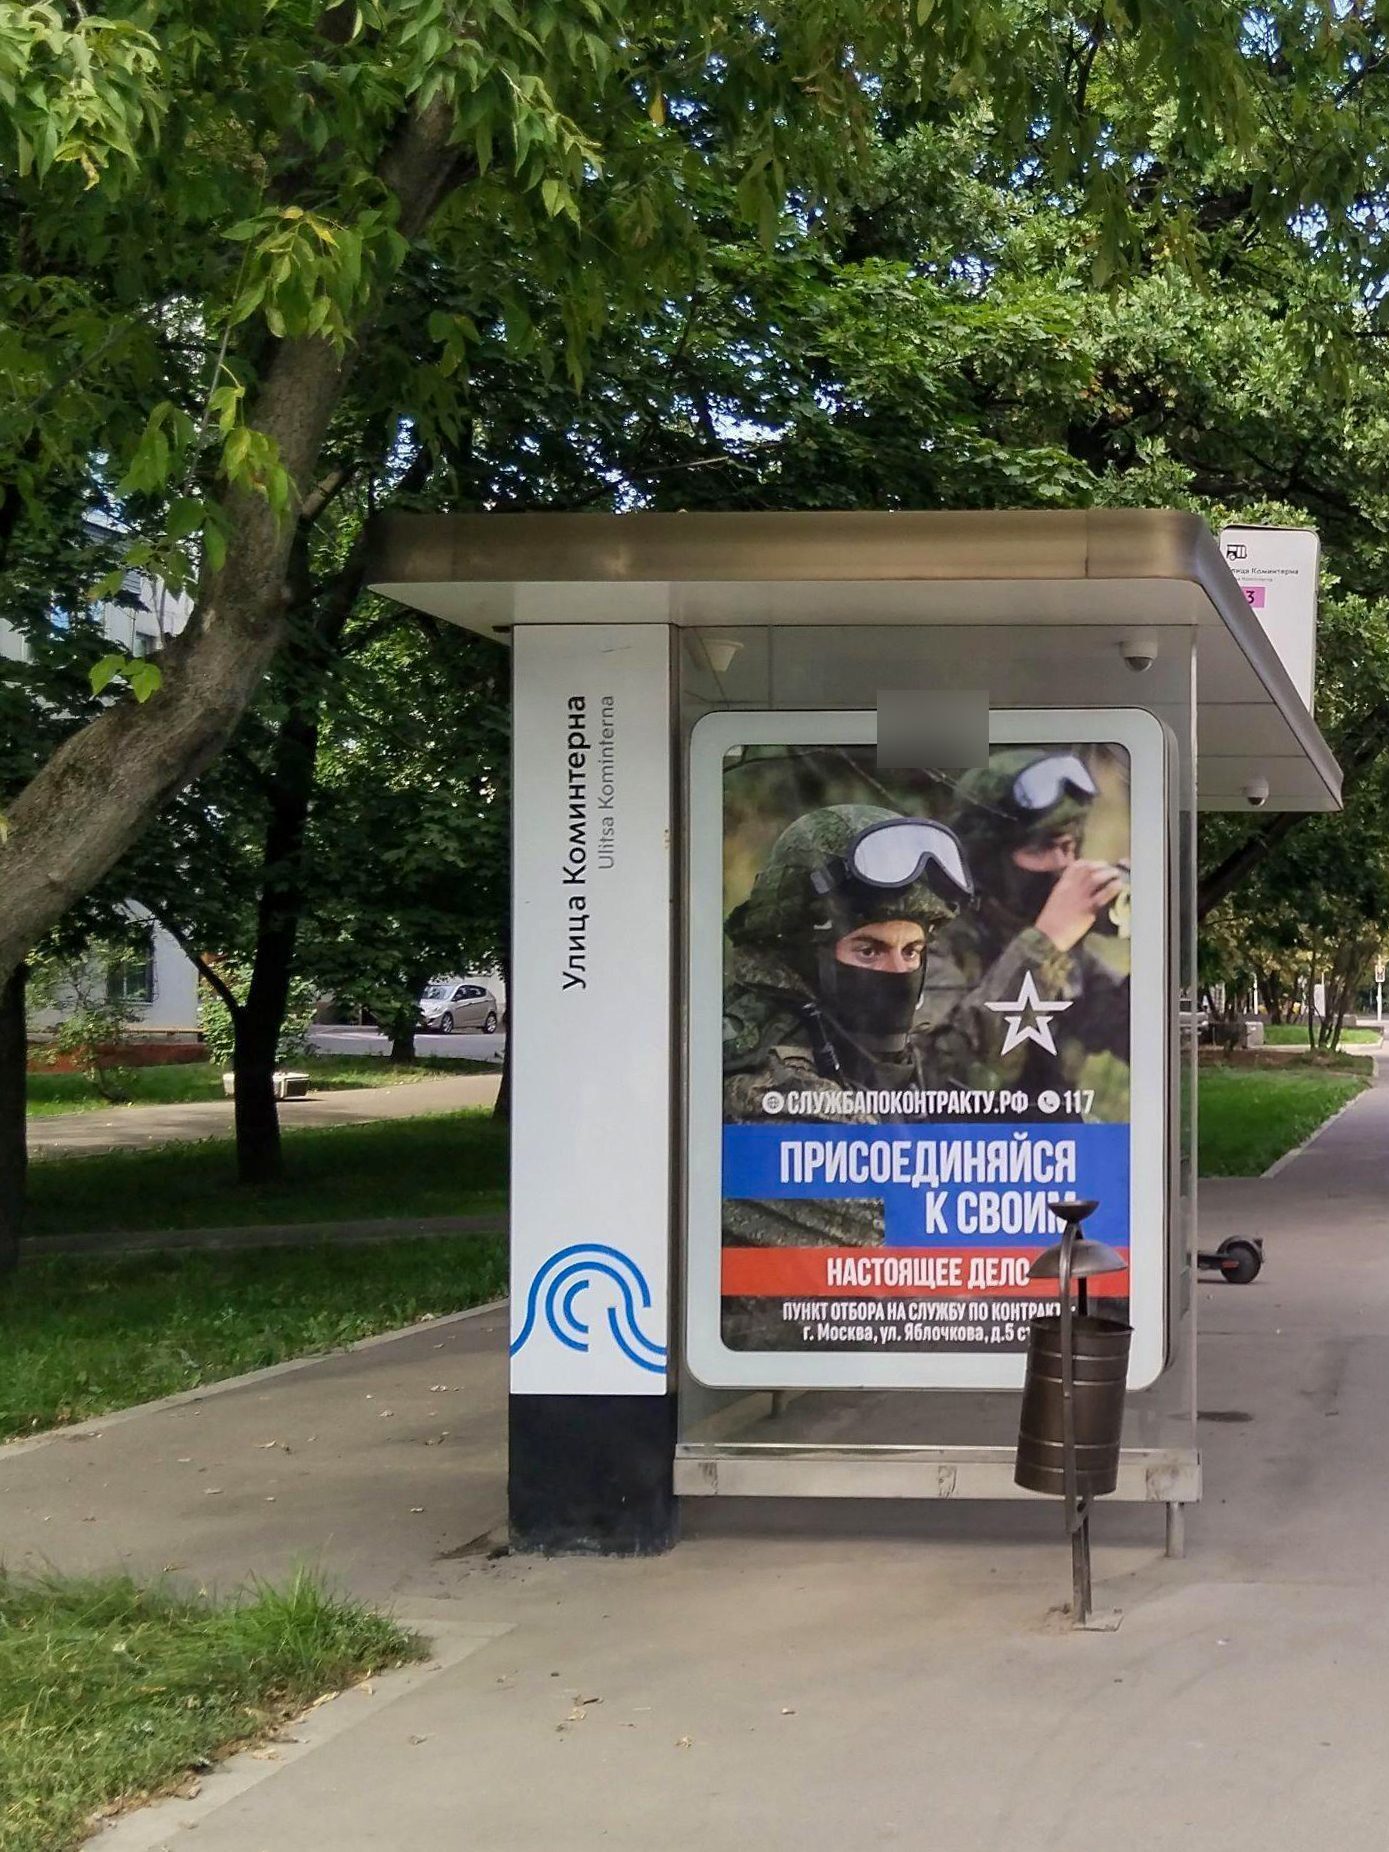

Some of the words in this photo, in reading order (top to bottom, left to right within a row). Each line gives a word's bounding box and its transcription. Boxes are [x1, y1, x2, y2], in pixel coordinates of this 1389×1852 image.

[598, 695, 614, 810] Kominterna
[562, 695, 591, 885] Коминтерна
[598, 815, 614, 870] Ulitsa
[562, 895, 590, 990] Улица
[787, 1090, 1029, 1114] СЛУЖБАПОКОНТРАКТУ.РФ
[1063, 1090, 1095, 1114] 117
[780, 1131, 1076, 1189] ПРИСОЕДИНЯЙСЯ
[925, 1190, 948, 1234] К
[827, 1257, 963, 1290] НАСТОЯЩЕЕ
[967, 1257, 1031, 1290] ДЕЛО
[782, 1302, 828, 1321] ПУНКТ
[830, 1302, 885, 1321] ОТБОРА
[887, 1302, 907, 1321] НА
[908, 1302, 966, 1322] СЛУЖБУ
[968, 1302, 988, 1321] ПО
[991, 1302, 1076, 1321] КОНТРАКТ
[803, 1326, 814, 1341] г.
[817, 1323, 878, 1344] Москва,
[880, 1326, 901, 1344] ул.
[904, 1323, 989, 1344] Яблочкова,
[990, 1322, 1015, 1344] д.5
